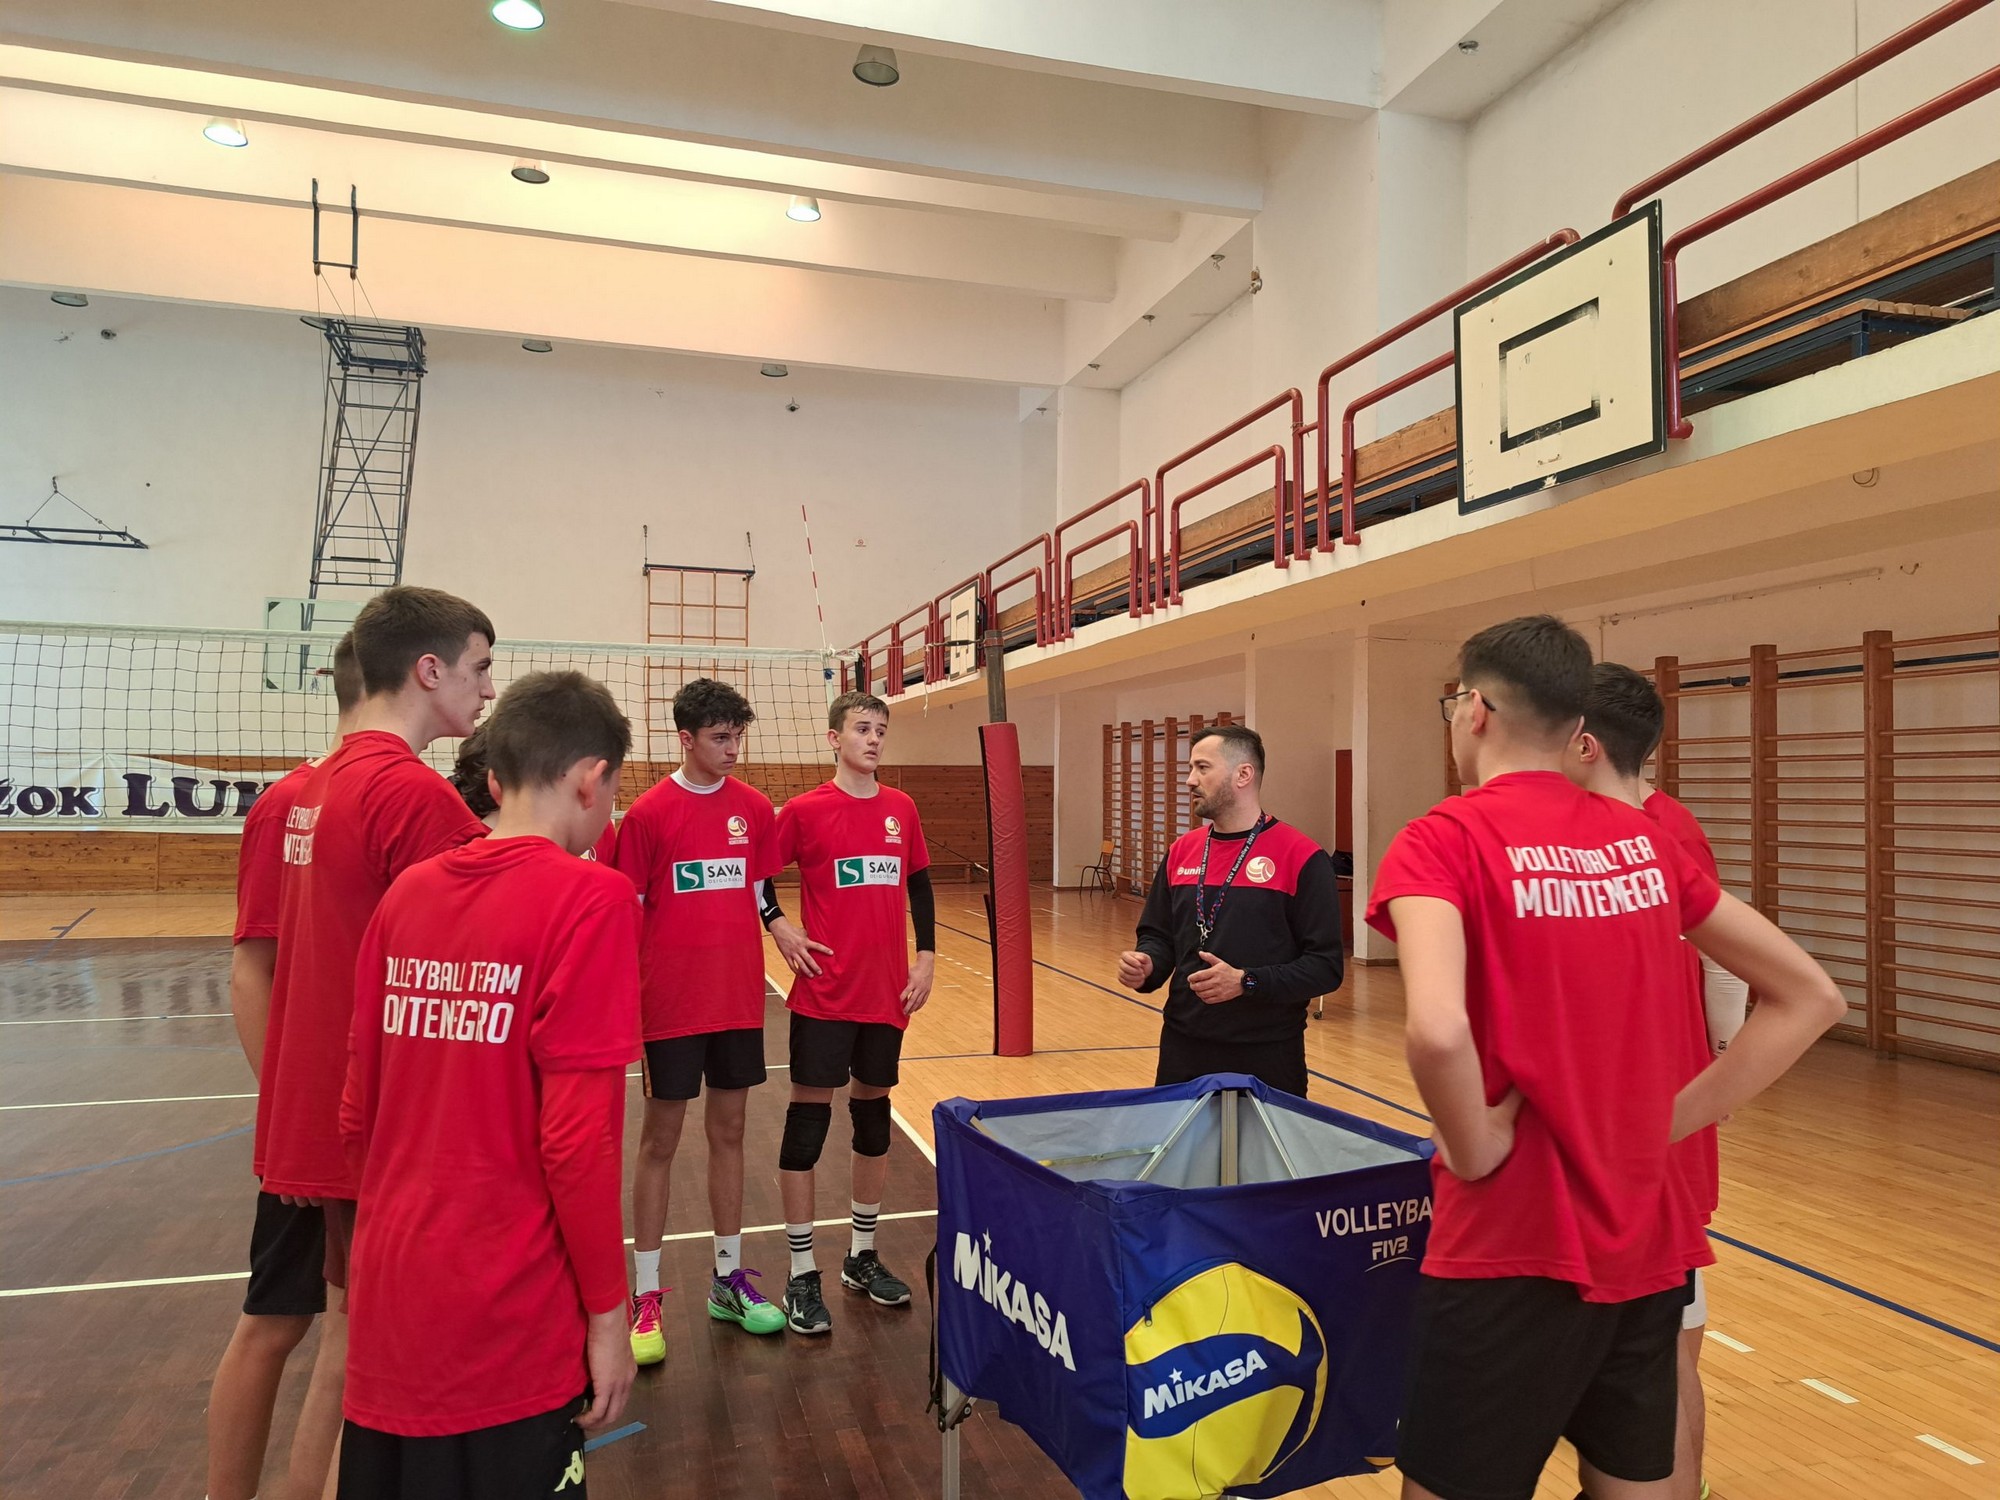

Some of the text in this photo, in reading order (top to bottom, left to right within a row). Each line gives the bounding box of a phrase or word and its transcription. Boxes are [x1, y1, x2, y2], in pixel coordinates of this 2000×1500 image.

[707, 864, 743, 878] SAVA
[468, 961, 523, 995] TEAM
[1315, 1196, 1433, 1238] VOLLEYBA
[1372, 1236, 1409, 1260] FIVB
